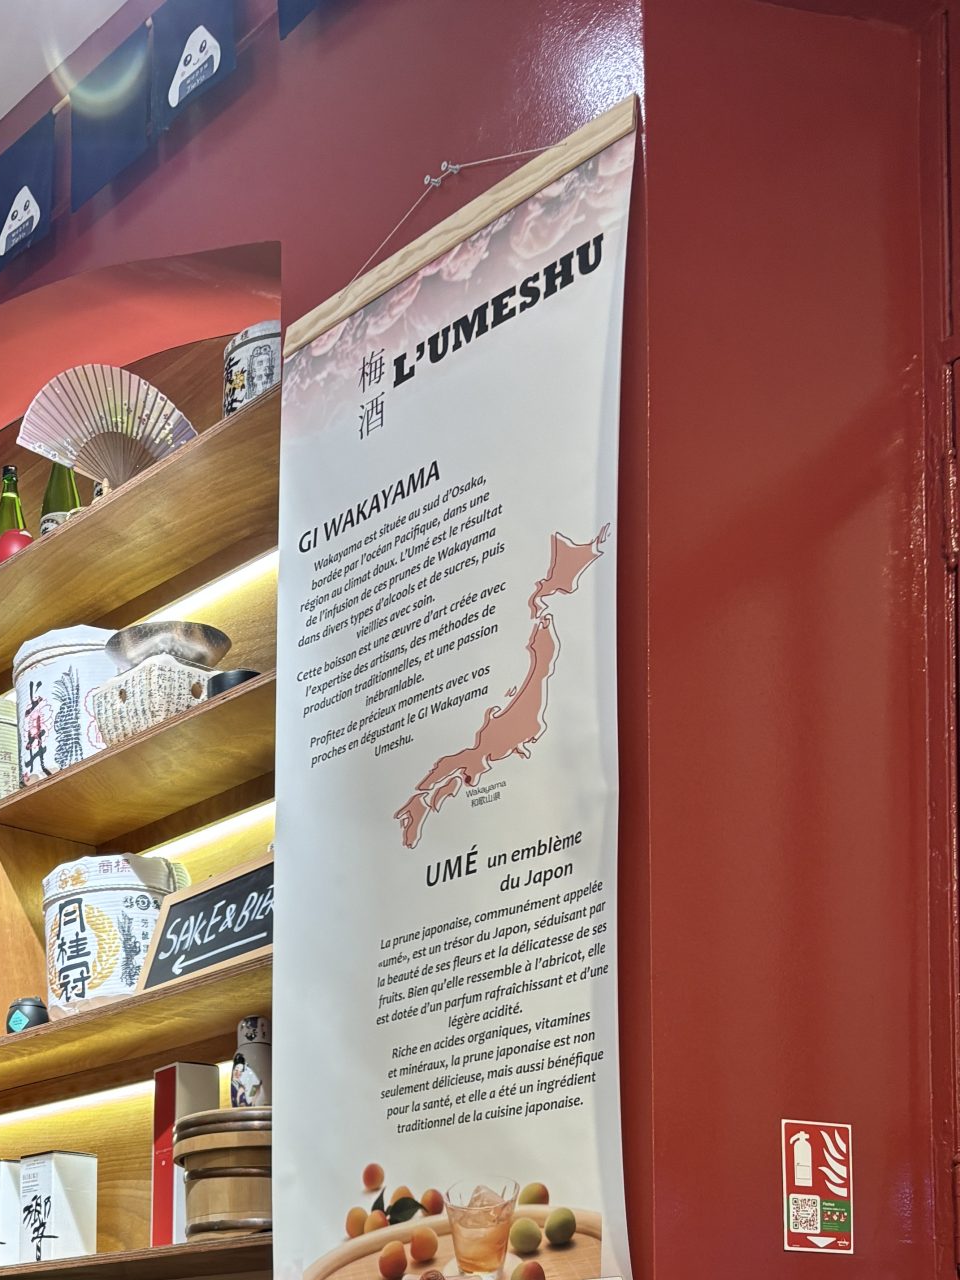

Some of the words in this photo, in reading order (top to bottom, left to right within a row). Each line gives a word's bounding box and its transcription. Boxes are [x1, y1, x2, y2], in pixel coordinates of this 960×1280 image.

[393, 233, 604, 388] L'UMESHU
[357, 348, 385, 440] 梅酒
[299, 527, 318, 553] GI
[324, 460, 440, 541] WAKAYAMA
[312, 568, 342, 590] bordée
[344, 560, 359, 577] par
[361, 542, 392, 565] l'océan
[394, 518, 440, 547] Pacifique,
[443, 503, 467, 521] dans
[470, 492, 490, 508] une
[314, 540, 362, 571] Wakayama
[364, 530, 377, 545] est
[379, 516, 406, 537] située
[408, 508, 420, 521] au
[422, 494, 440, 514] sud
[442, 476, 486, 503] d'Osaka,
[300, 594, 329, 612] région
[332, 587, 342, 598] au
[344, 570, 371, 591] climat
[373, 558, 397, 576] doux.
[400, 537, 430, 562] L'Umé
[432, 530, 446, 546] est
[449, 526, 458, 538] le
[461, 504, 502, 532] résultat
[297, 667, 322, 682] Cette
[324, 651, 356, 672] boisson
[359, 642, 371, 655] est
[374, 634, 390, 648] une
[392, 619, 421, 639] œuvre
[424, 605, 448, 624] d'art
[450, 592, 478, 612] créée
[480, 582, 506, 599] avec
[306, 671, 352, 697] l'expertise
[354, 663, 368, 676] des
[370, 645, 407, 668] artisans,
[410, 635, 426, 648] des
[429, 612, 479, 640] méthodes
[482, 604, 496, 618] de
[357, 616, 388, 638] vieillies
[390, 605, 410, 622] avec
[412, 595, 435, 611] soin.
[310, 728, 345, 748] Profitez
[347, 721, 357, 733] de
[359, 704, 396, 731] précieux
[398, 684, 443, 710] moments
[446, 673, 469, 690] avec
[472, 666, 490, 679] vos
[366, 673, 424, 706] inébranlable.
[311, 744, 346, 768] proches
[348, 740, 358, 750] en
[361, 718, 405, 744] dégustant
[407, 713, 416, 724] le
[418, 707, 428, 719] GI
[431, 686, 488, 714] Wakayama
[375, 735, 414, 756] Umeshu.
[465, 780, 507, 798] Wakayama
[426, 844, 478, 886] UMÉ
[488, 853, 506, 868] un
[511, 831, 582, 862] emblème
[500, 874, 520, 891] du
[524, 863, 572, 886] Japon
[381, 940, 390, 949] La
[393, 931, 420, 949] prune
[422, 917, 471, 940] japonaise,
[475, 894, 560, 923] communément
[564, 880, 602, 904] appelée
[57, 898, 91, 1002] 月桂冠
[378, 977, 385, 988] la
[388, 966, 419, 985] beauté
[422, 964, 433, 976] de
[435, 961, 450, 972] ses
[453, 954, 482, 971] fleurs
[484, 949, 496, 960] et
[498, 946, 508, 957] la
[512, 933, 574, 954] délicatesse
[576, 926, 590, 939] de
[592, 922, 607, 935] ses
[392, 1045, 417, 1058] Riche
[420, 1044, 431, 1053] en
[434, 1035, 465, 1050] acides
[468, 1024, 531, 1044] organiques,
[535, 1012, 590, 1030] vitamines
[448, 1013, 480, 1029] légère
[483, 1002, 522, 1020] acidité.
[380, 1081, 430, 1099] seulement
[432, 1073, 484, 1089] délicieuse,
[487, 1065, 513, 1079] mais
[516, 1058, 544, 1074] aussi
[548, 1051, 604, 1069] bénéfique
[398, 1113, 455, 1133] traditionnel
[458, 1112, 470, 1124] de
[473, 1110, 482, 1121] la
[485, 1105, 522, 1119] cuisine
[525, 1096, 583, 1117] japonaise.
